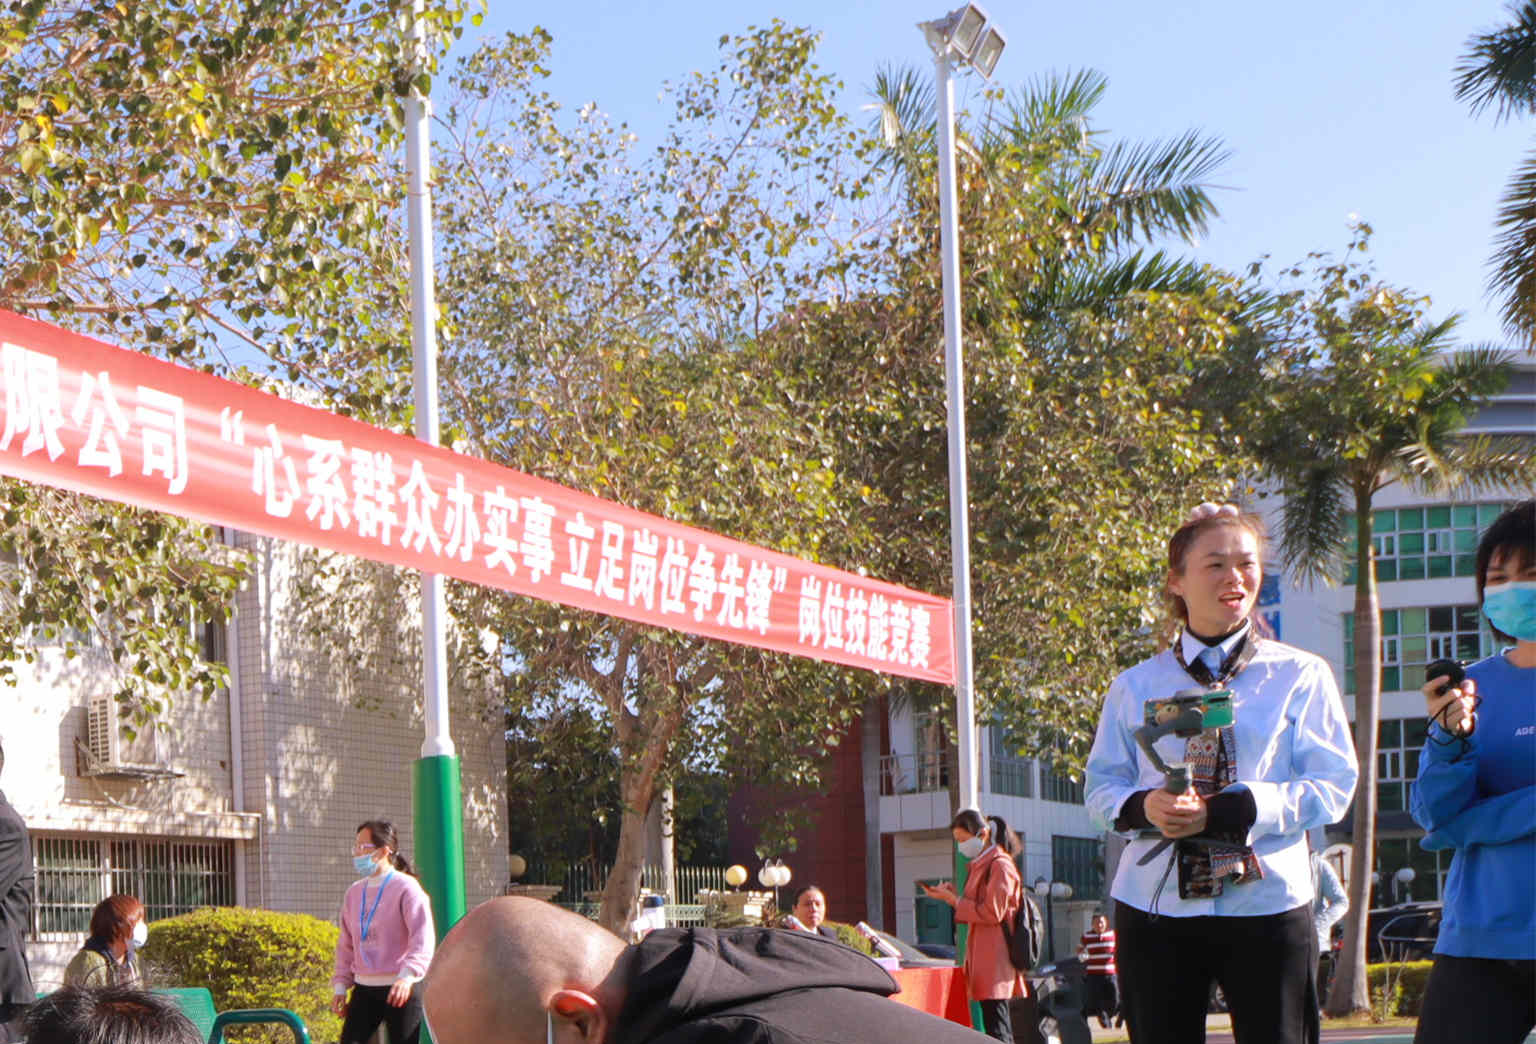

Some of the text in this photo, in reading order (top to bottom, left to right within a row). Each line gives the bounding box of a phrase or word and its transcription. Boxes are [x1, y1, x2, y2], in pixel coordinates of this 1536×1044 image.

[798, 575, 932, 668] 岗位技能竞赛
